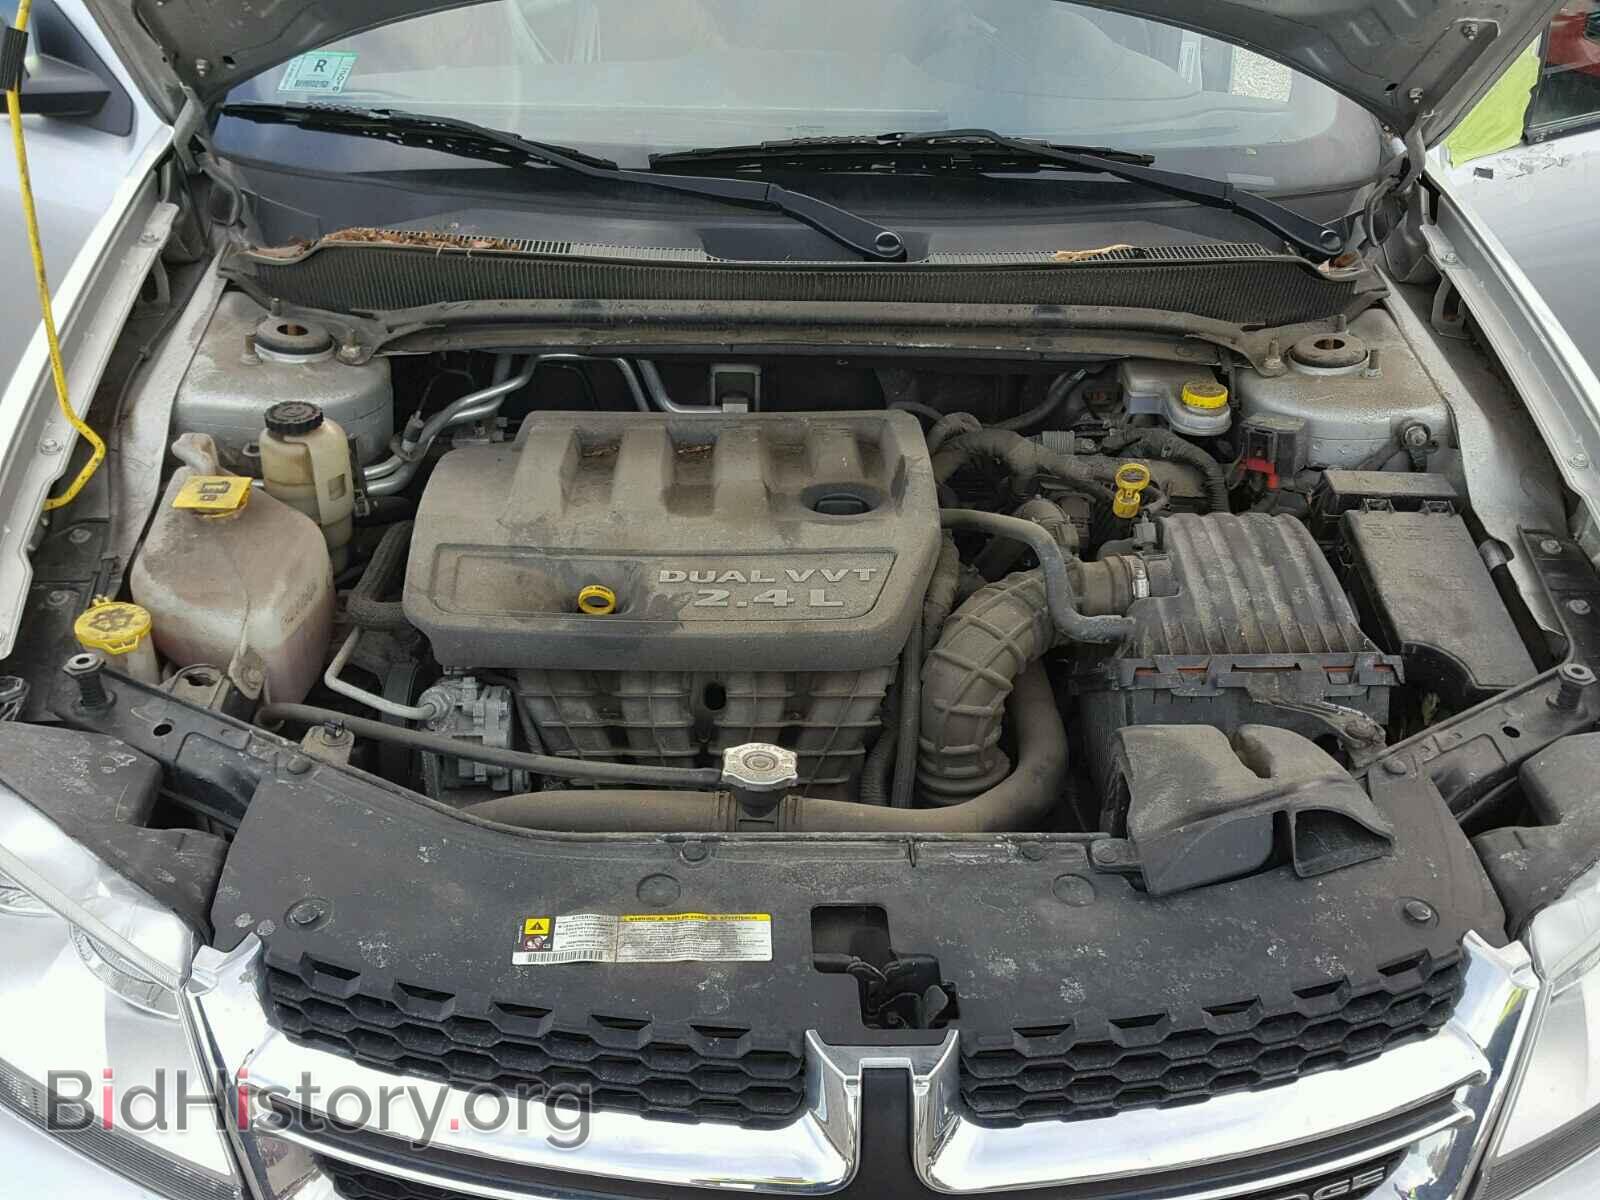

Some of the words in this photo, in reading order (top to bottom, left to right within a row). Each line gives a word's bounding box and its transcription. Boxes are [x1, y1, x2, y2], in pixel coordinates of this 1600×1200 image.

[313, 59, 328, 73] R
[658, 569, 776, 584] DUAL
[784, 568, 878, 583] VVT
